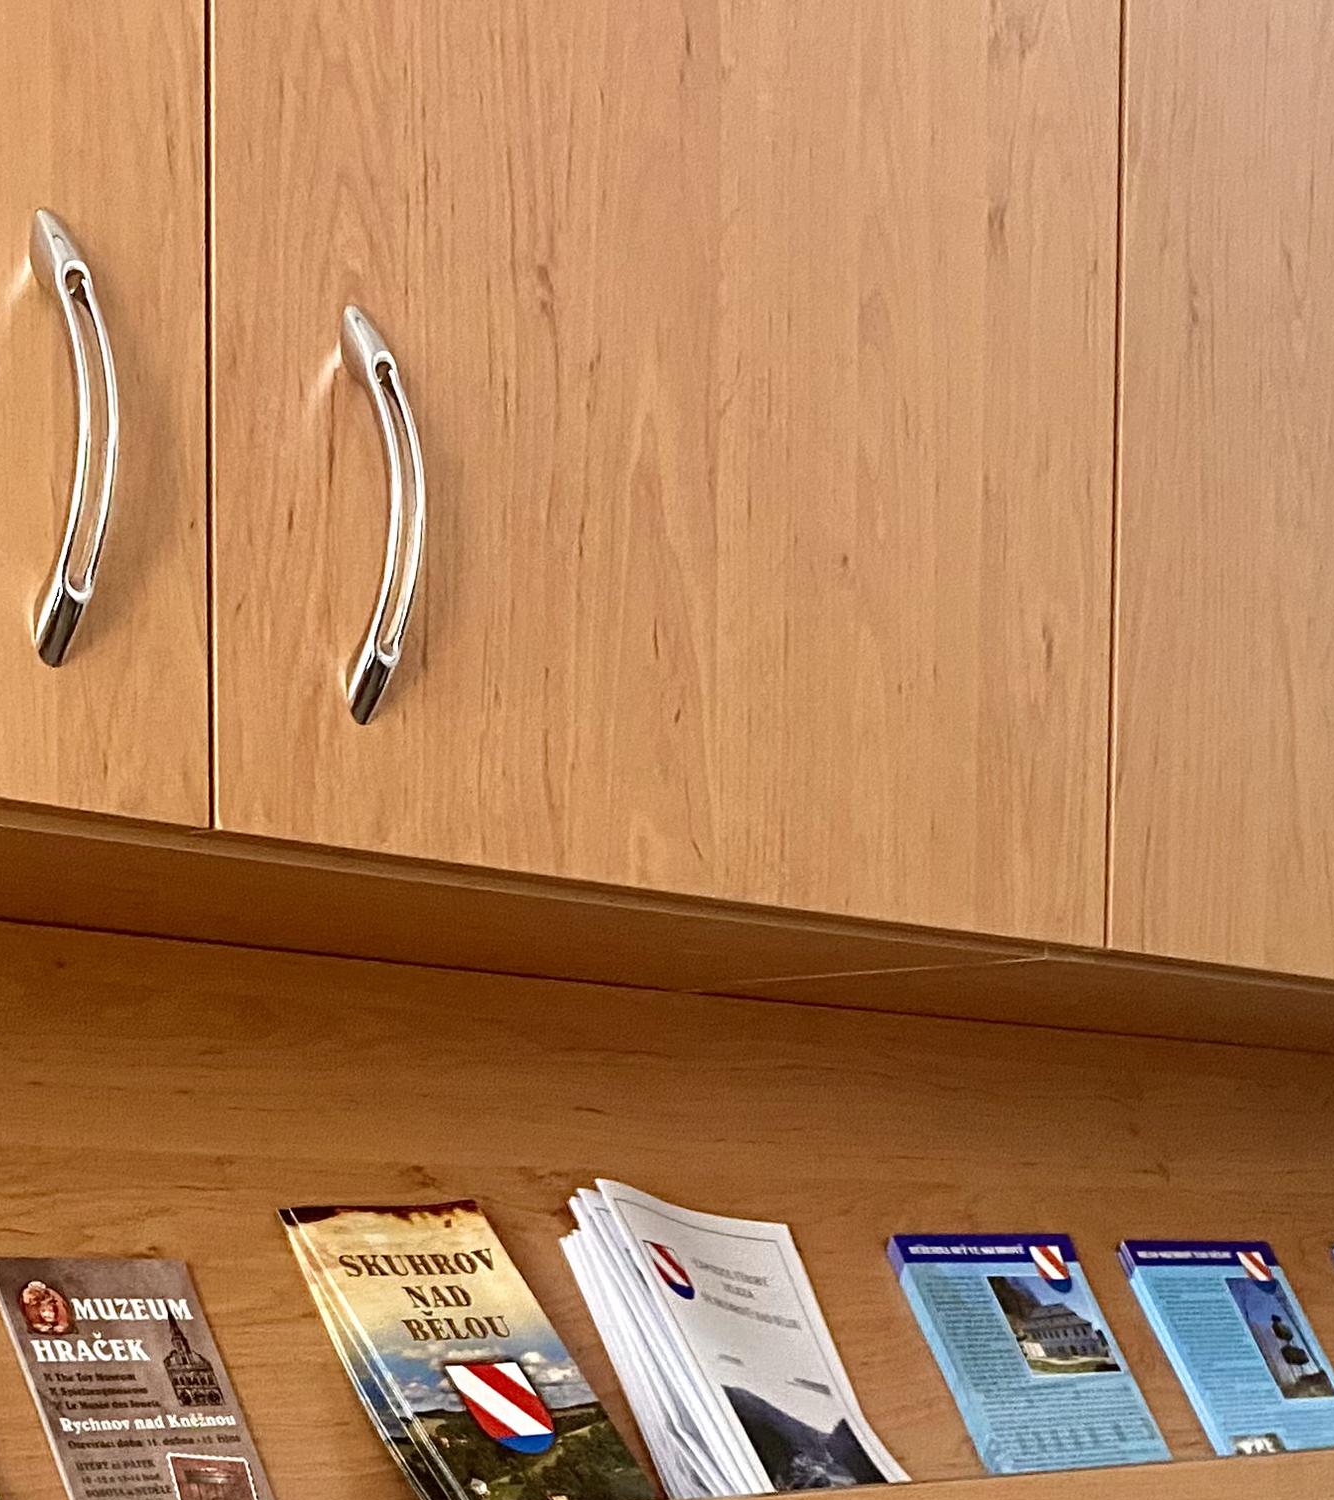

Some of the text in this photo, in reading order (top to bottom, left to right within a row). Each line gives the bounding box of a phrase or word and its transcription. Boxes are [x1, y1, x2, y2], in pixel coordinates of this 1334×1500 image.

[338, 1248, 497, 1278] SKUHROV
[70, 1298, 194, 1321] MUZEUM
[403, 1284, 473, 1309] NAD
[401, 1311, 511, 1342] BĚLOU
[30, 1332, 151, 1363] HRAČEK
[59, 1413, 237, 1434] Rychnov nad Kněžnou
